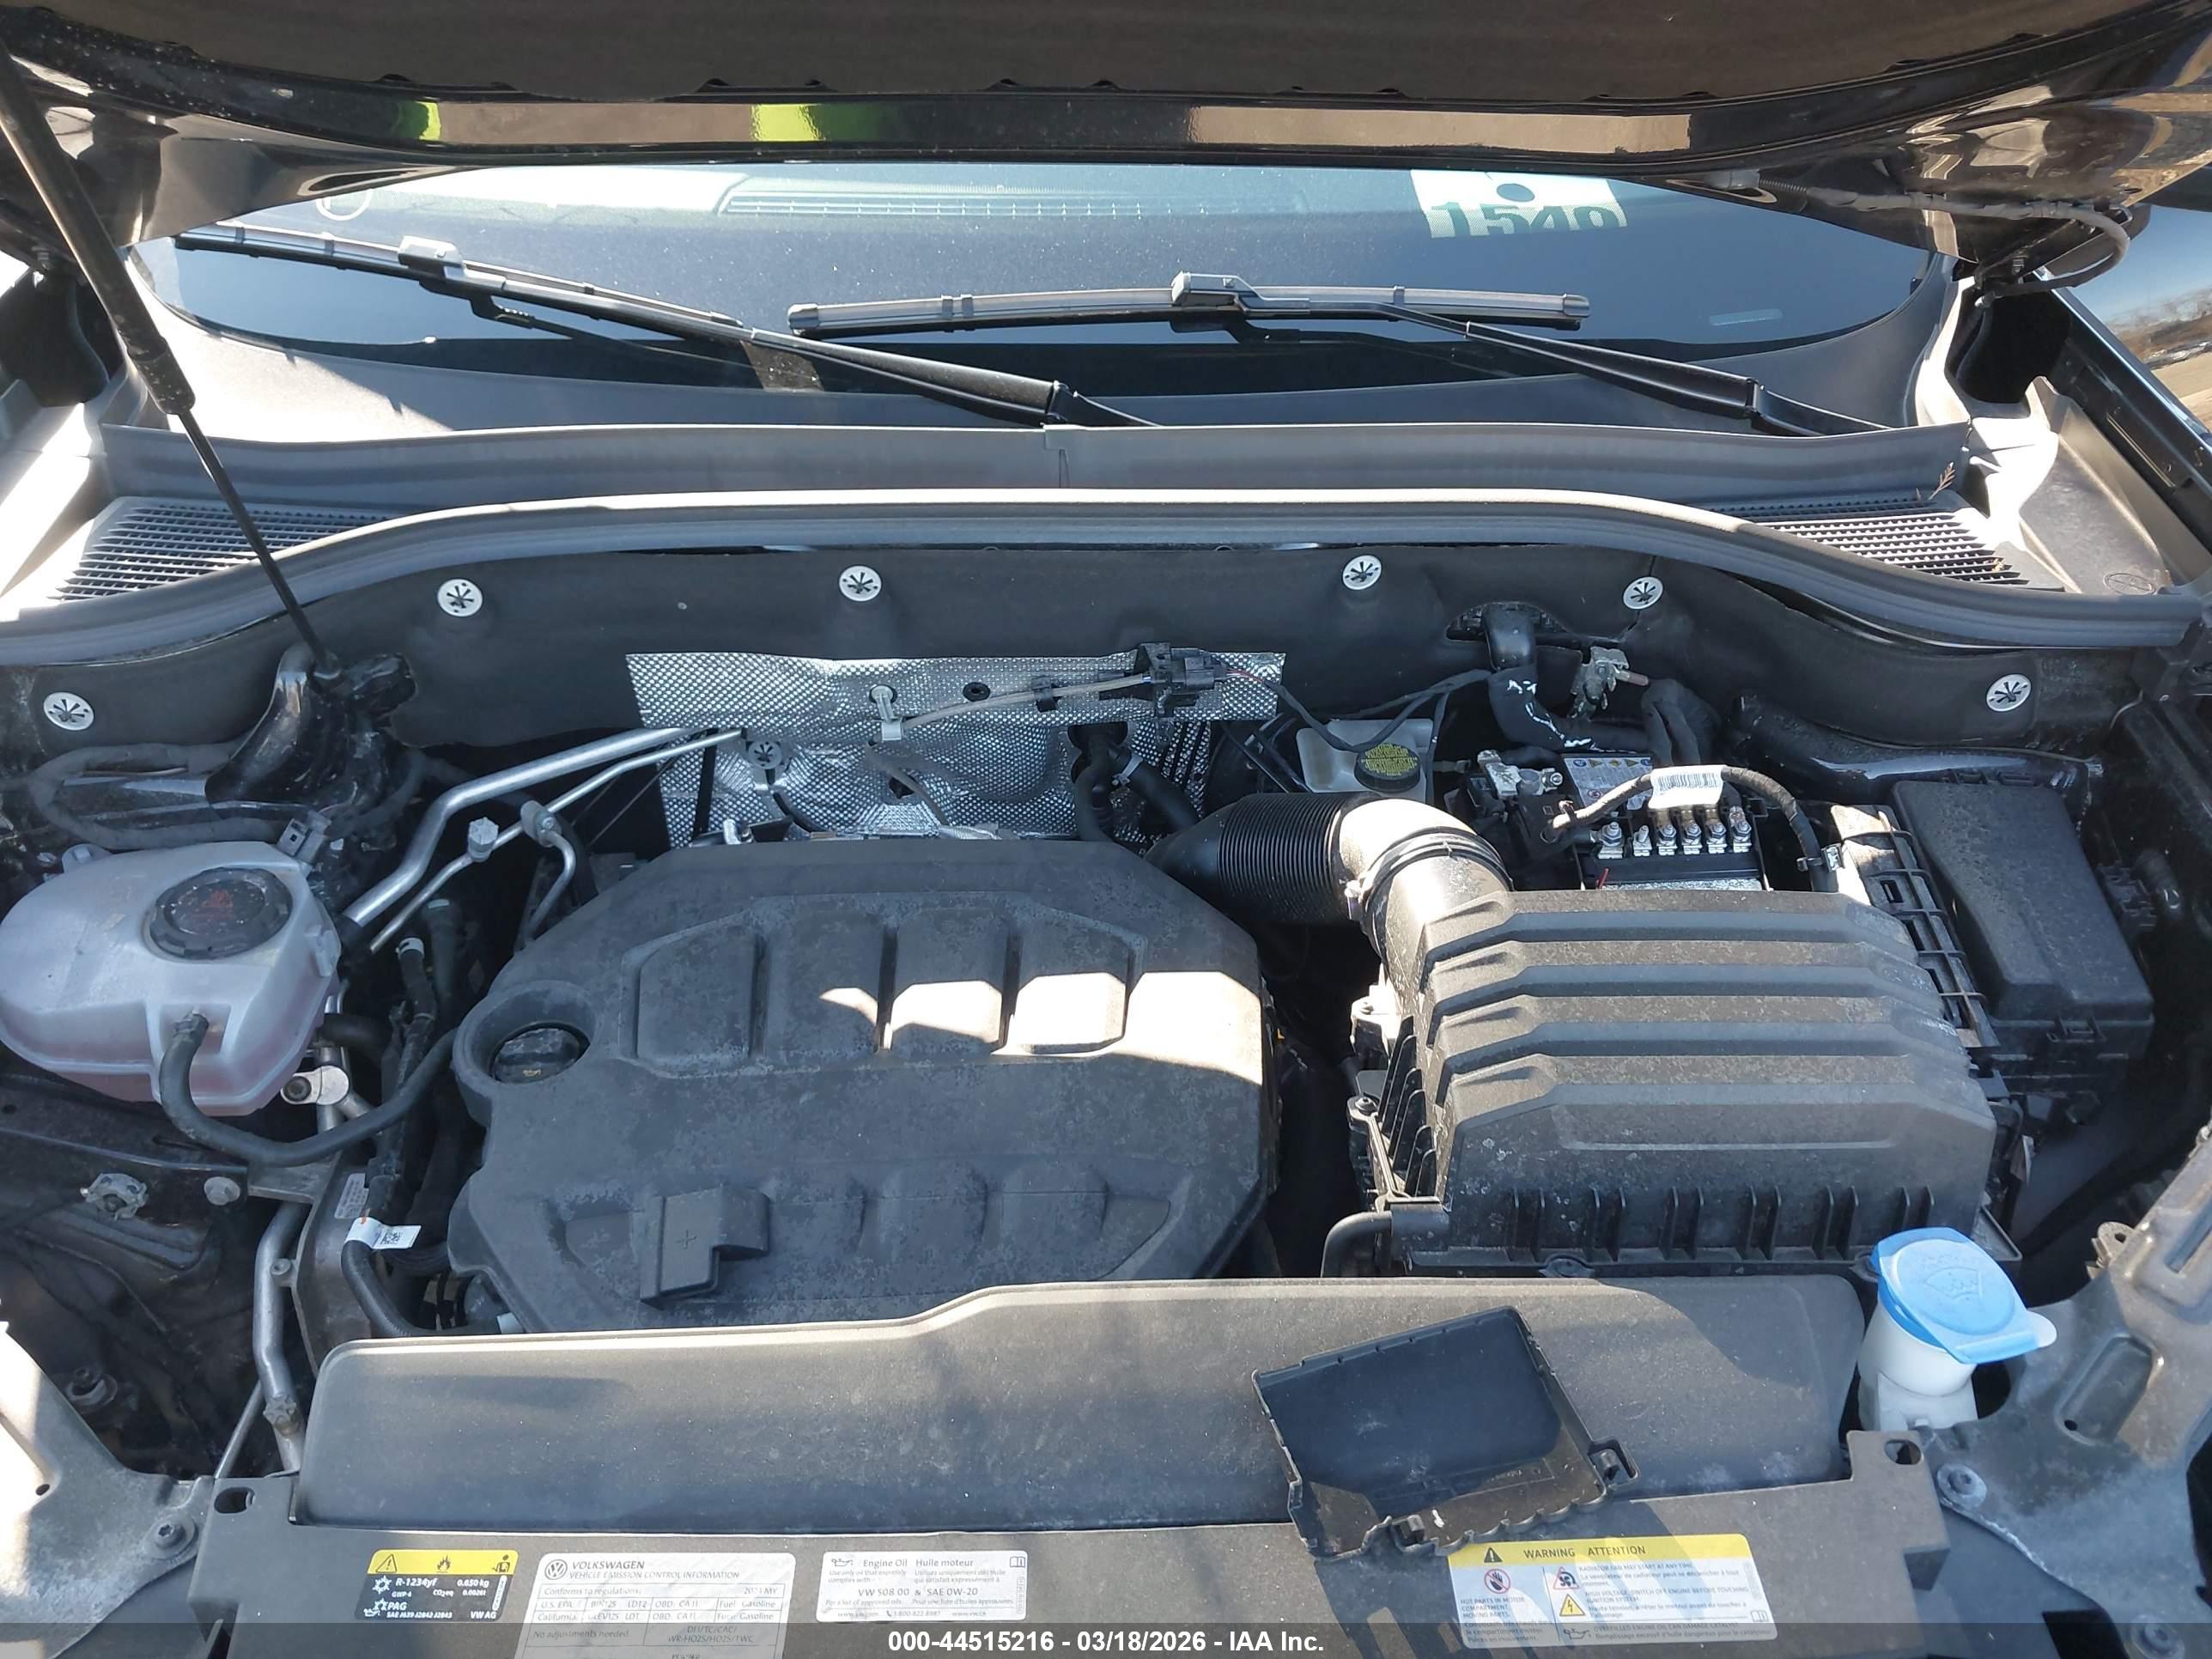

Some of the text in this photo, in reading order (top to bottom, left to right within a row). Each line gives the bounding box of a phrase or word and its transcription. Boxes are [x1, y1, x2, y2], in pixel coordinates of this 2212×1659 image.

[1523, 1546, 1646, 1559] WARNING ATTENTION
[572, 1560, 644, 1570] VOLKSWAGEN
[863, 1559, 908, 1569] Engine Oil
[915, 1559, 939, 1567] Huile
[395, 1577, 438, 1588] R-1234yf
[479, 1578, 489, 1589] kg
[544, 1586, 582, 1595] Conforms
[387, 1602, 408, 1611] PAG
[742, 1600, 775, 1608] Gasoline
[470, 1611, 483, 1620] VW
[484, 1611, 497, 1620] AG
[534, 1630, 545, 1638] No
[547, 1630, 597, 1640] adjustments
